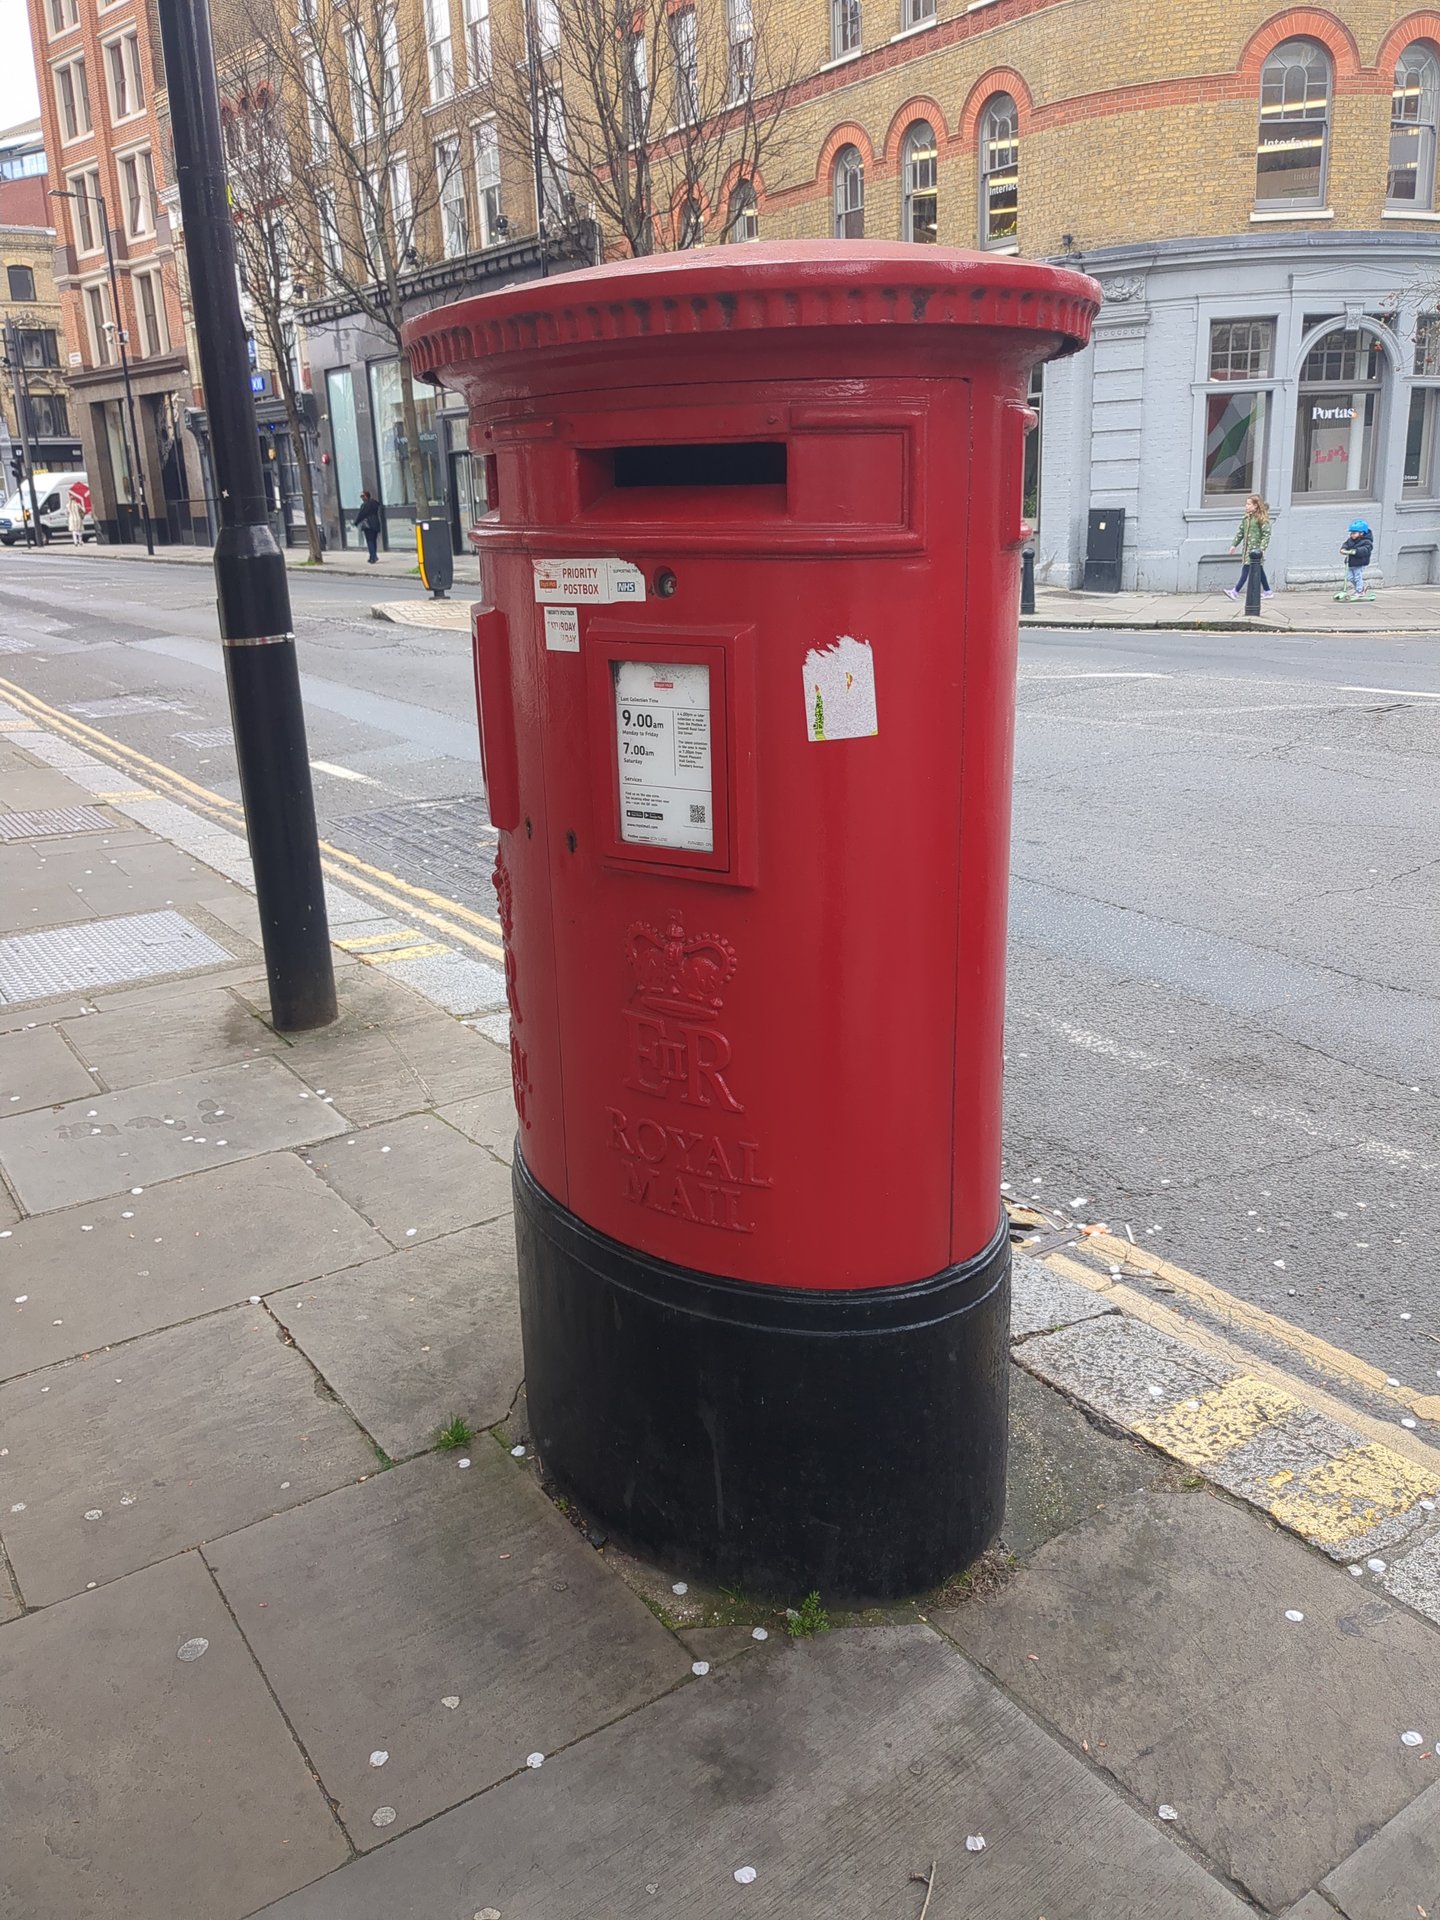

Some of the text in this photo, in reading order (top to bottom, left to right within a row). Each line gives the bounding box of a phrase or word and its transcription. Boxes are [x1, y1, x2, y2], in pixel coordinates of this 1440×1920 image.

[562, 568, 598, 579] PRIORITY
[563, 584, 600, 595] POSTBOX
[617, 583, 634, 592] NHS
[622, 709, 664, 729] 9.00am
[645, 731, 659, 739] Friday
[623, 742, 655, 757] 7.00am
[605, 1105, 775, 1188] ROYAL
[622, 1160, 757, 1233] MAIL
